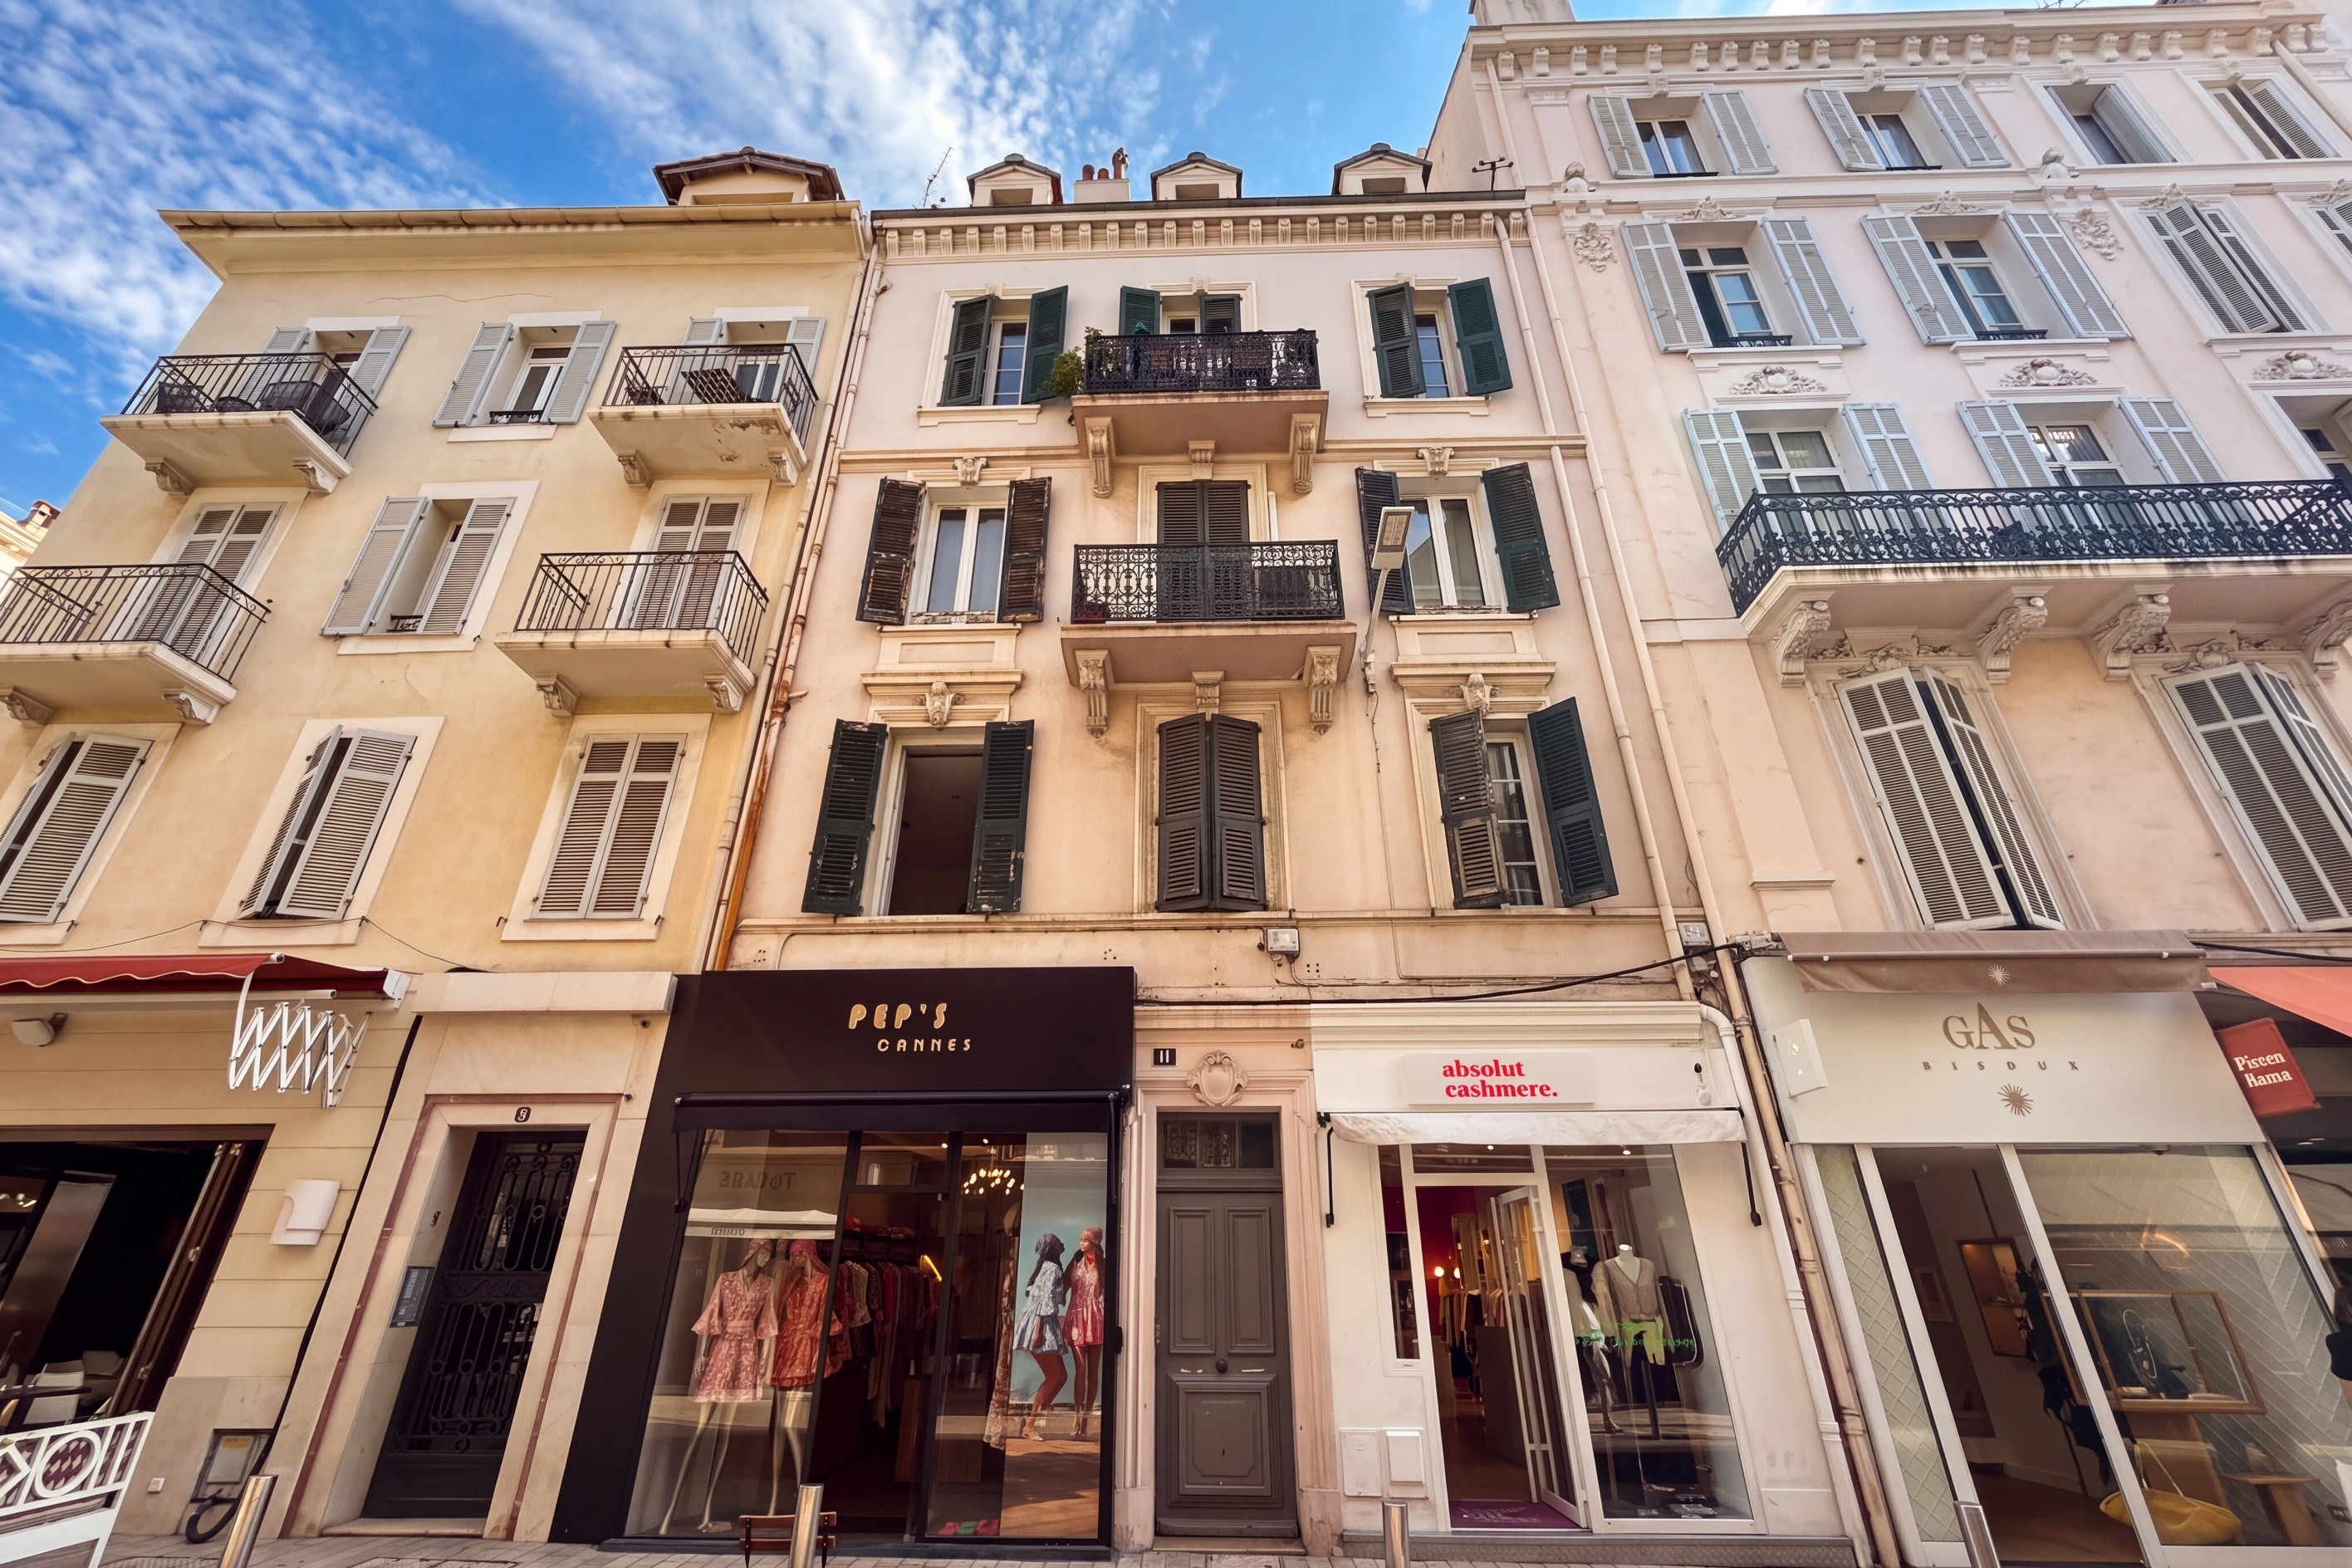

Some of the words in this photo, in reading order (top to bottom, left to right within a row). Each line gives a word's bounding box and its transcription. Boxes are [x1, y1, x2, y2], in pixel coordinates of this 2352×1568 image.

[848, 1002, 947, 1030] PEP'S
[1942, 1002, 2036, 1050] GAS
[877, 1038, 971, 1052] CANNES
[1442, 1059, 1526, 1078] absolut
[1445, 1079, 1558, 1098] cashmere.
[2244, 1070, 2293, 1088] Hama
